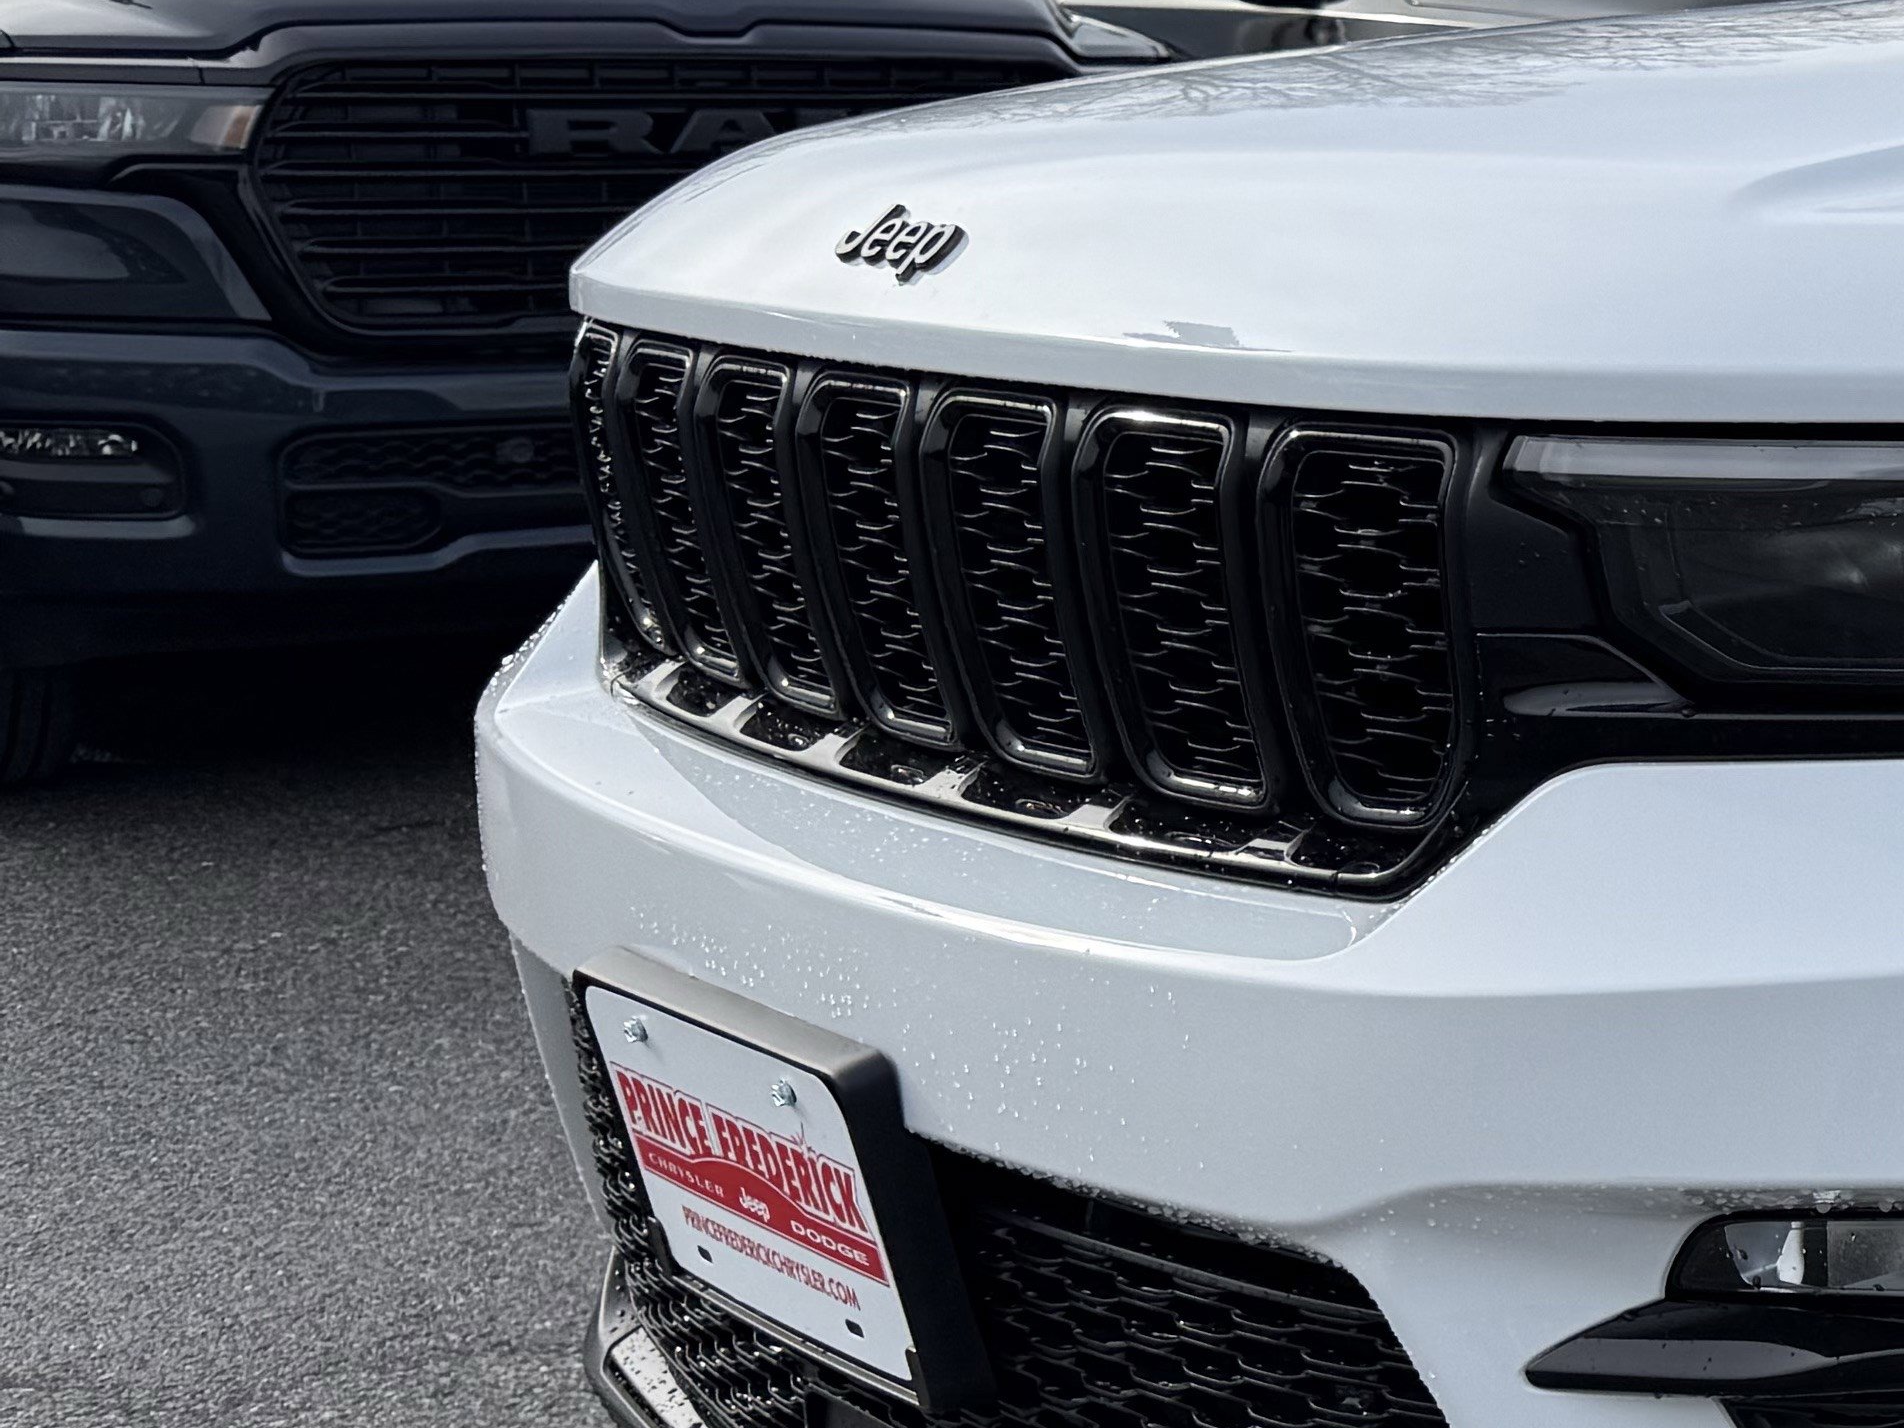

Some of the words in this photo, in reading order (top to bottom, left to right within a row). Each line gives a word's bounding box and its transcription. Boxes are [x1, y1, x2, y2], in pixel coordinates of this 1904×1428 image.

[526, 107, 852, 155] RA
[834, 203, 969, 285] Jeep
[612, 1065, 718, 1156] PRINCE
[709, 1107, 872, 1235] FREDERICK
[648, 1151, 726, 1199] CHRYSLER
[738, 1187, 771, 1222] Jeep
[789, 1219, 871, 1266] DODGE
